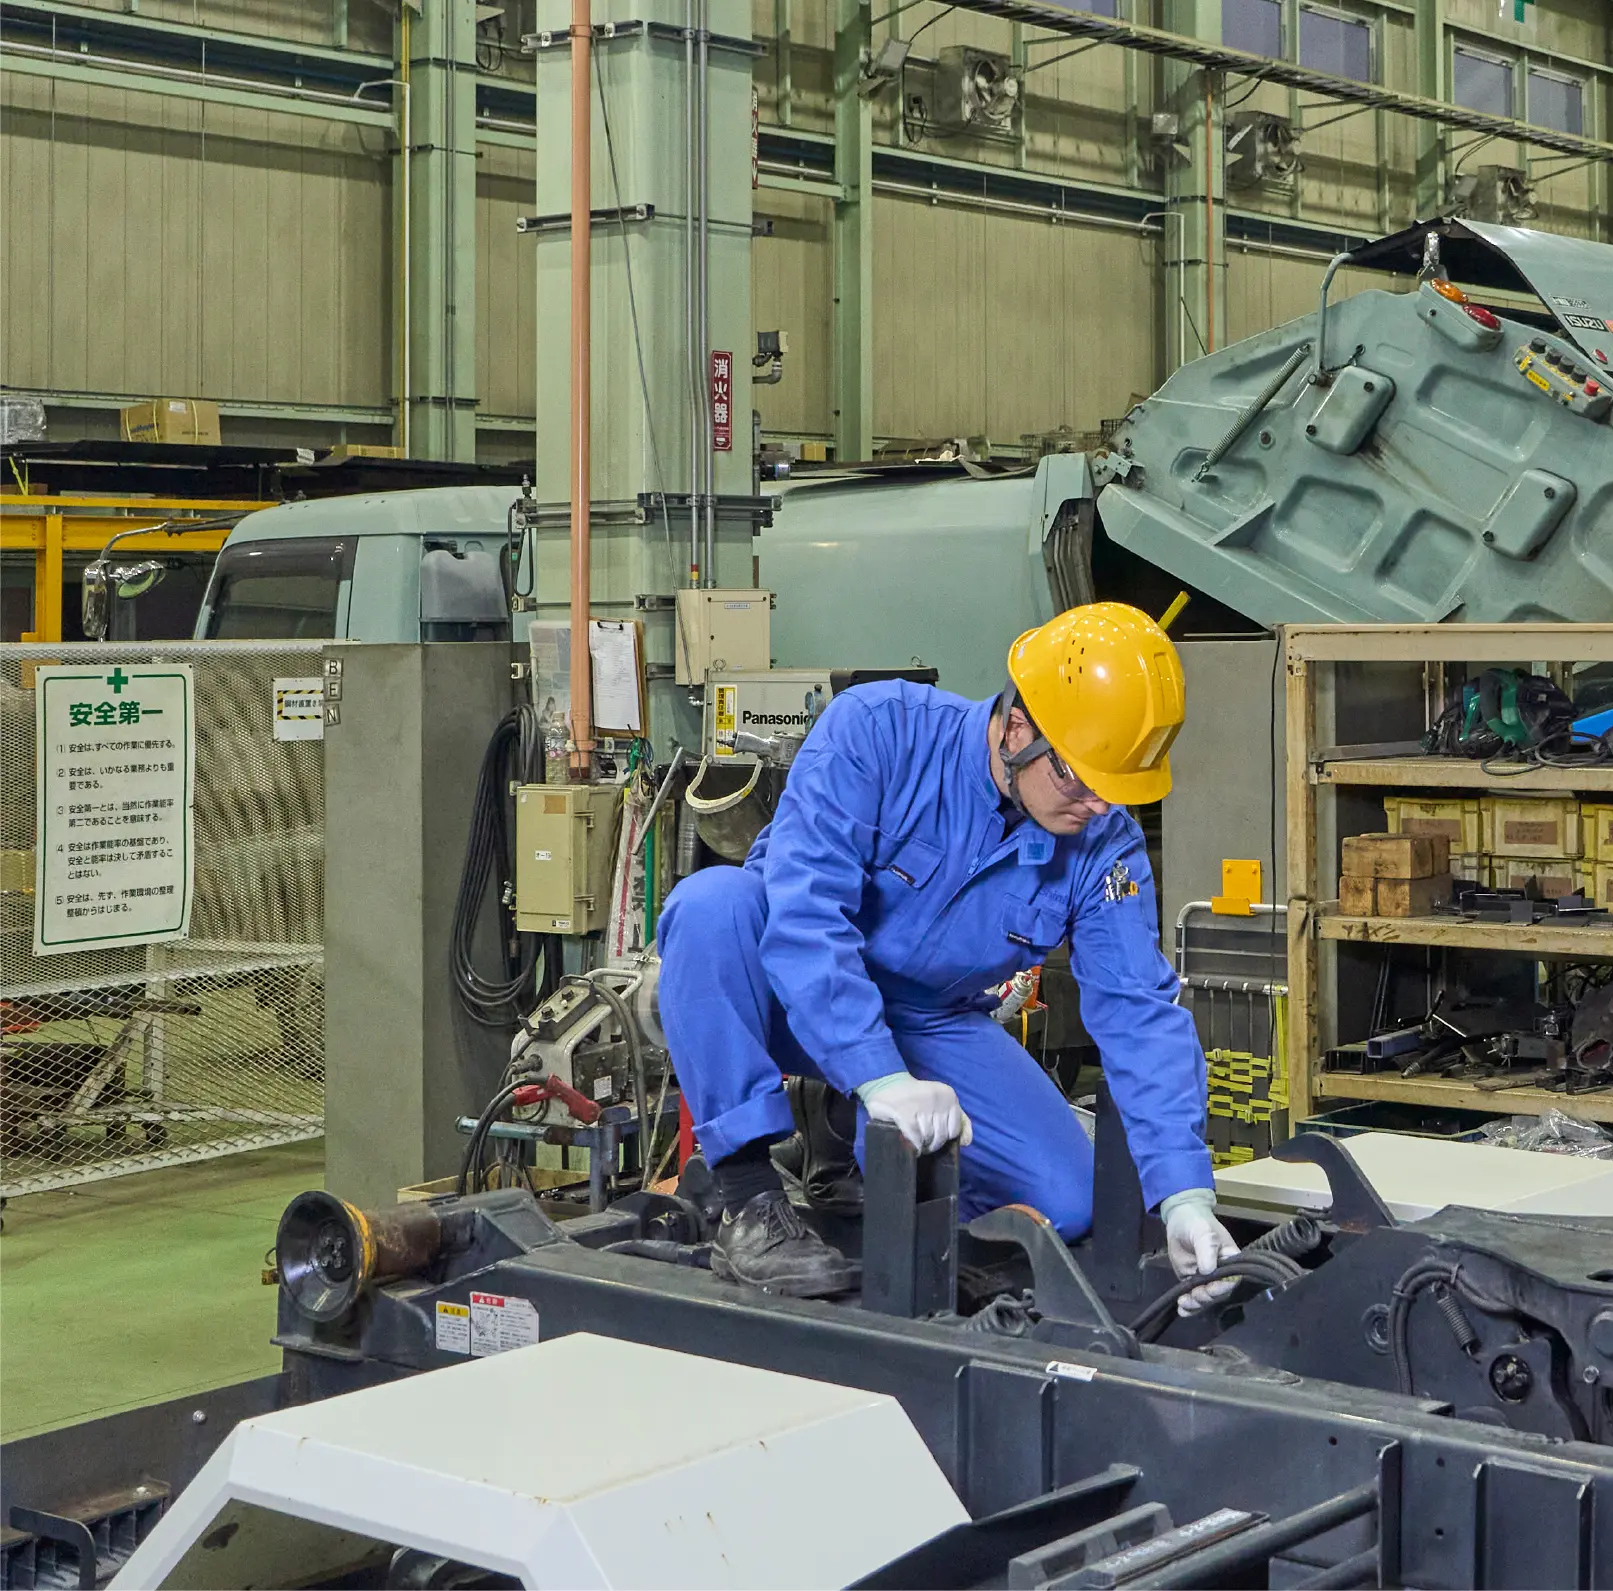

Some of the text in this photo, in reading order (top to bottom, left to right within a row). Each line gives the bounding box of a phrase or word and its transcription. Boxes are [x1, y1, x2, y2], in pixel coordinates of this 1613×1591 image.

[1565, 315, 1605, 330] ISUZU
[714, 358, 728, 423] 消火器
[69, 701, 163, 727] 安全第一
